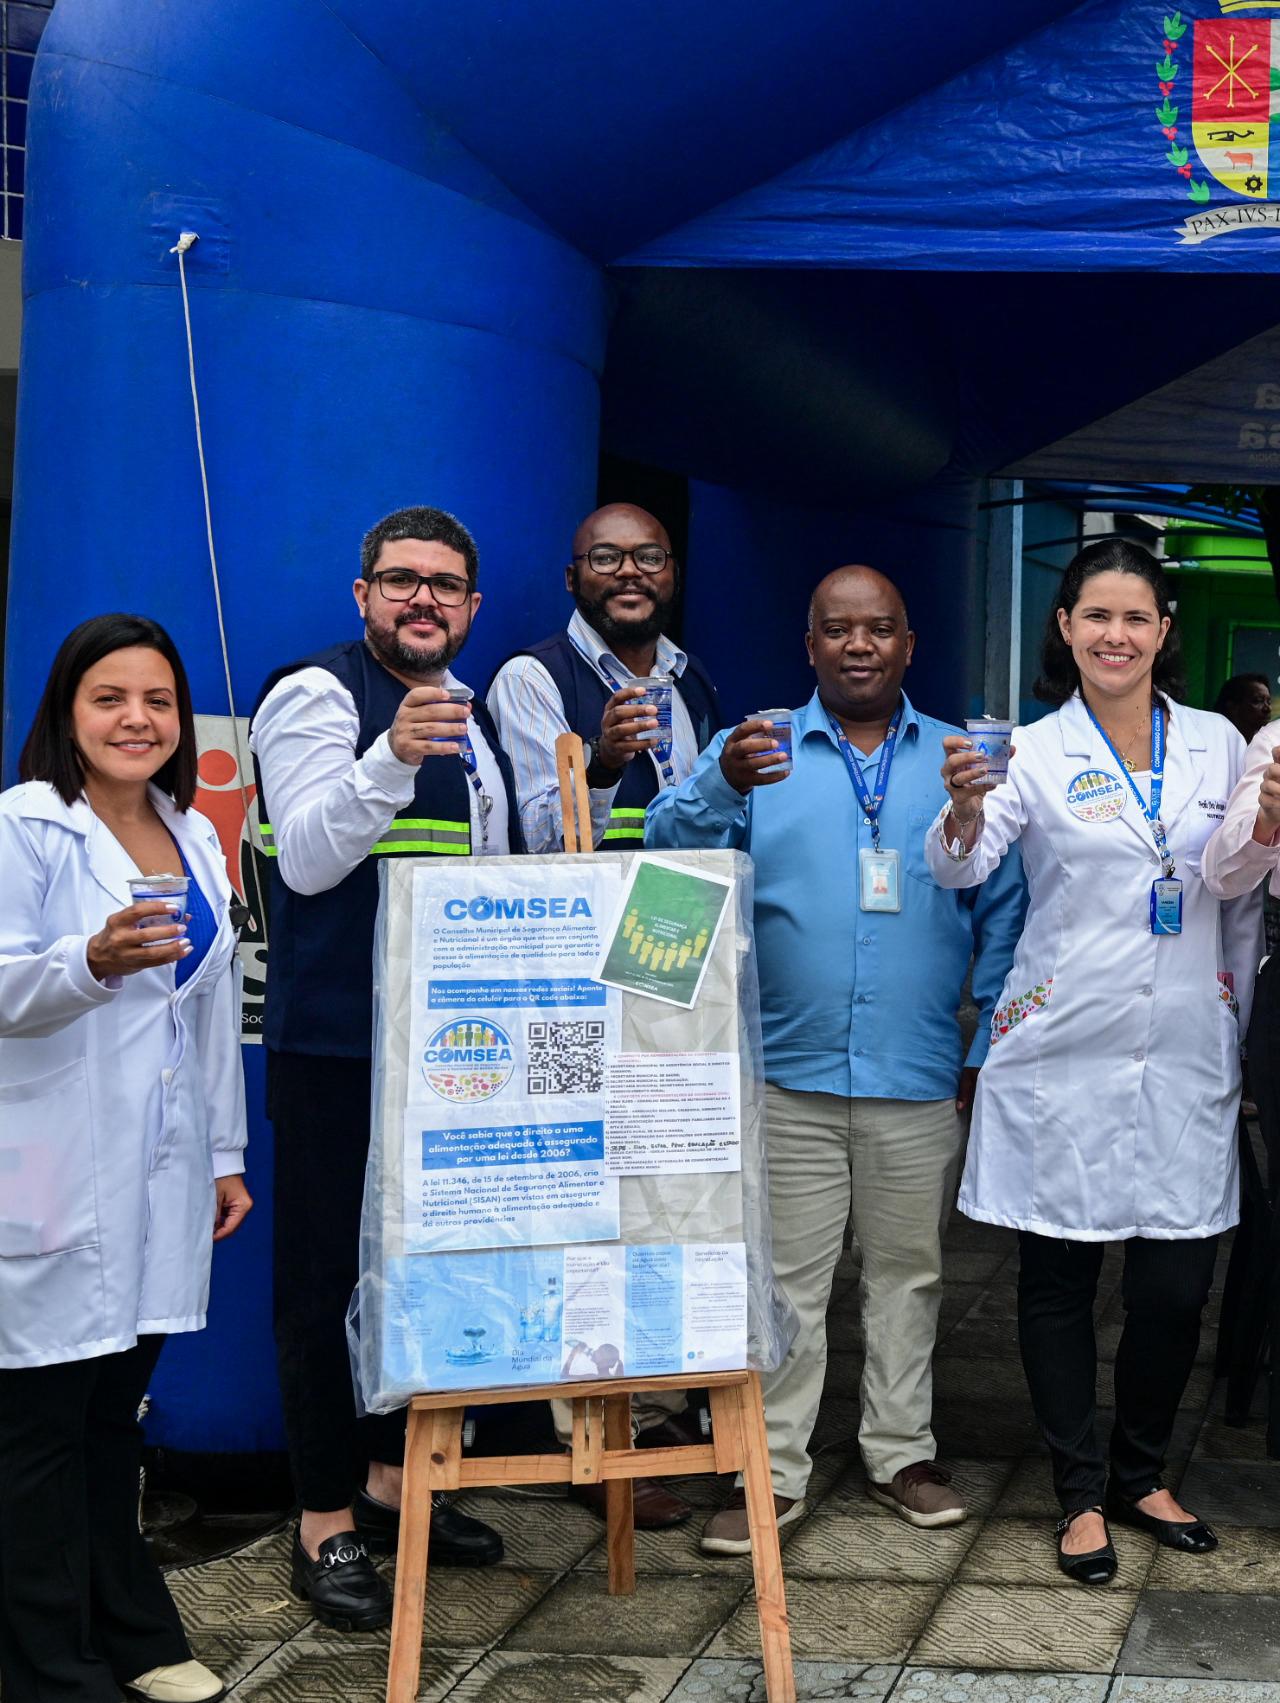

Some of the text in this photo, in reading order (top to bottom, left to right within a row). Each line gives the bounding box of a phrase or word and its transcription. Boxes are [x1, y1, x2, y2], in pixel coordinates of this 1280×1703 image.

[1067, 782, 1123, 803] COMSEA
[444, 896, 592, 921] COMSEA
[476, 926, 510, 935] Municipal
[522, 926, 560, 934] Segurança
[500, 935, 521, 943] órgão
[568, 933, 598, 942] conjunto
[457, 943, 507, 952] administração
[510, 942, 544, 951] municipal
[565, 942, 594, 950] garantir
[465, 952, 509, 961] alimentação
[521, 951, 557, 959] qualidade
[433, 962, 471, 970] população
[447, 986, 488, 995] acompanhe
[438, 995, 465, 1003] câmera
[478, 994, 502, 1002] celular
[504, 995, 522, 1003] para
[424, 1048, 512, 1063] COMSEA
[443, 1132, 465, 1141] Você
[468, 1131, 493, 1139] sabia
[496, 1131, 512, 1139] que
[522, 1127, 553, 1136] direito
[429, 1144, 486, 1154] alimentação
[488, 1140, 534, 1150] adequada
[545, 1136, 597, 1147] assegurado
[457, 1156, 473, 1165] por
[498, 1152, 509, 1160] lei
[511, 1151, 538, 1159] desde
[541, 1148, 570, 1157] 2006?
[430, 1178, 441, 1186] lei
[442, 1177, 469, 1185] 11.346,
[472, 1176, 482, 1184] de
[506, 1172, 543, 1181] setembro
[546, 1171, 556, 1179] de
[558, 1170, 582, 1179] 2006,
[430, 1188, 462, 1196] Sistema
[464, 1186, 499, 1194] Nacional
[514, 1183, 556, 1193] Segurança
[558, 1181, 597, 1189] Alimentar
[423, 1198, 468, 1207] Nutricional
[469, 1195, 501, 1205] (SISAN)
[560, 1190, 600, 1199] assegurar
[430, 1208, 456, 1216] direito
[459, 1207, 492, 1215] humano
[494, 1205, 499, 1213] à
[501, 1203, 551, 1213] alimentação
[552, 1201, 593, 1211] adequada
[422, 1215, 515, 1228] dá outras providências
[512, 1355, 542, 1363] Mundial
[512, 1362, 530, 1370] Água
